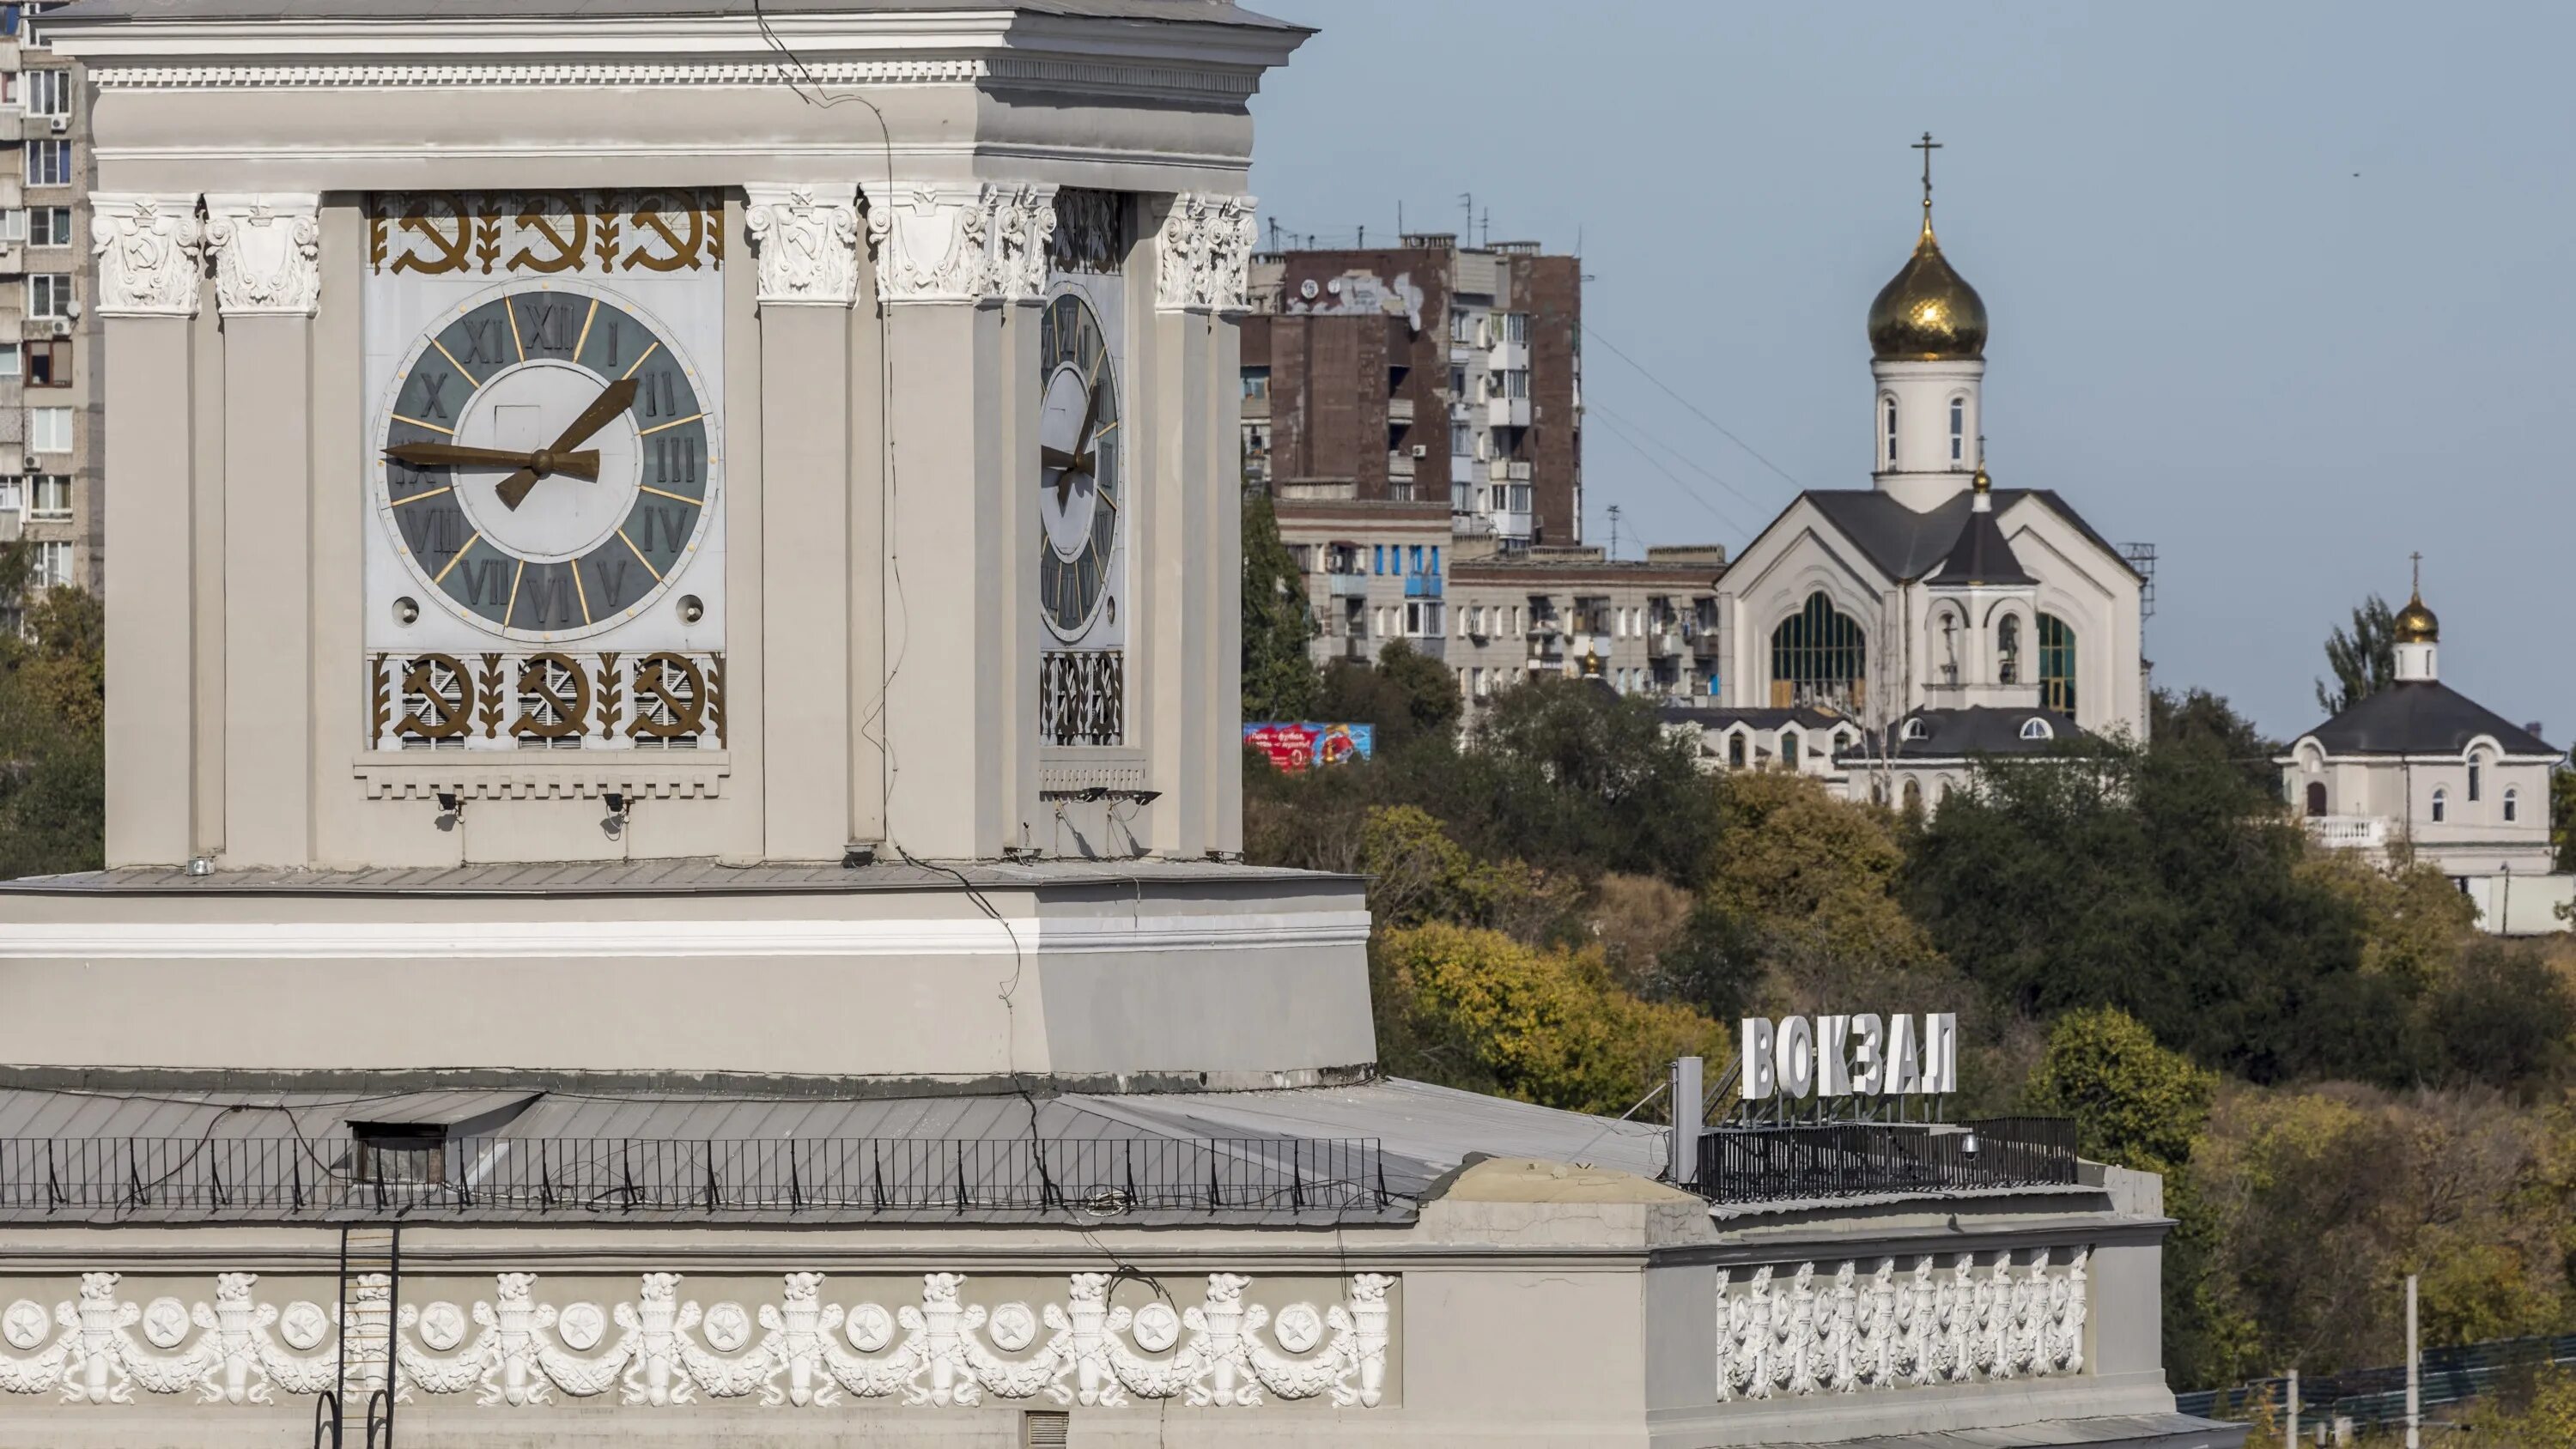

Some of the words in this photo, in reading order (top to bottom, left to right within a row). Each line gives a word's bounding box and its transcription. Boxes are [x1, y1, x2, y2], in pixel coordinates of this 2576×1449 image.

[462, 318, 503, 363] XI
[525, 303, 574, 349] XII
[608, 322, 617, 367] I
[421, 373, 448, 418] X
[646, 372, 676, 416] II
[657, 437, 695, 482] III
[405, 507, 460, 554] VIII
[644, 506, 688, 552] IV
[460, 560, 507, 605] VII
[526, 578, 569, 622] VI
[597, 560, 626, 606] V
[1741, 1012, 1957, 1100] ВОКЗАЛ
